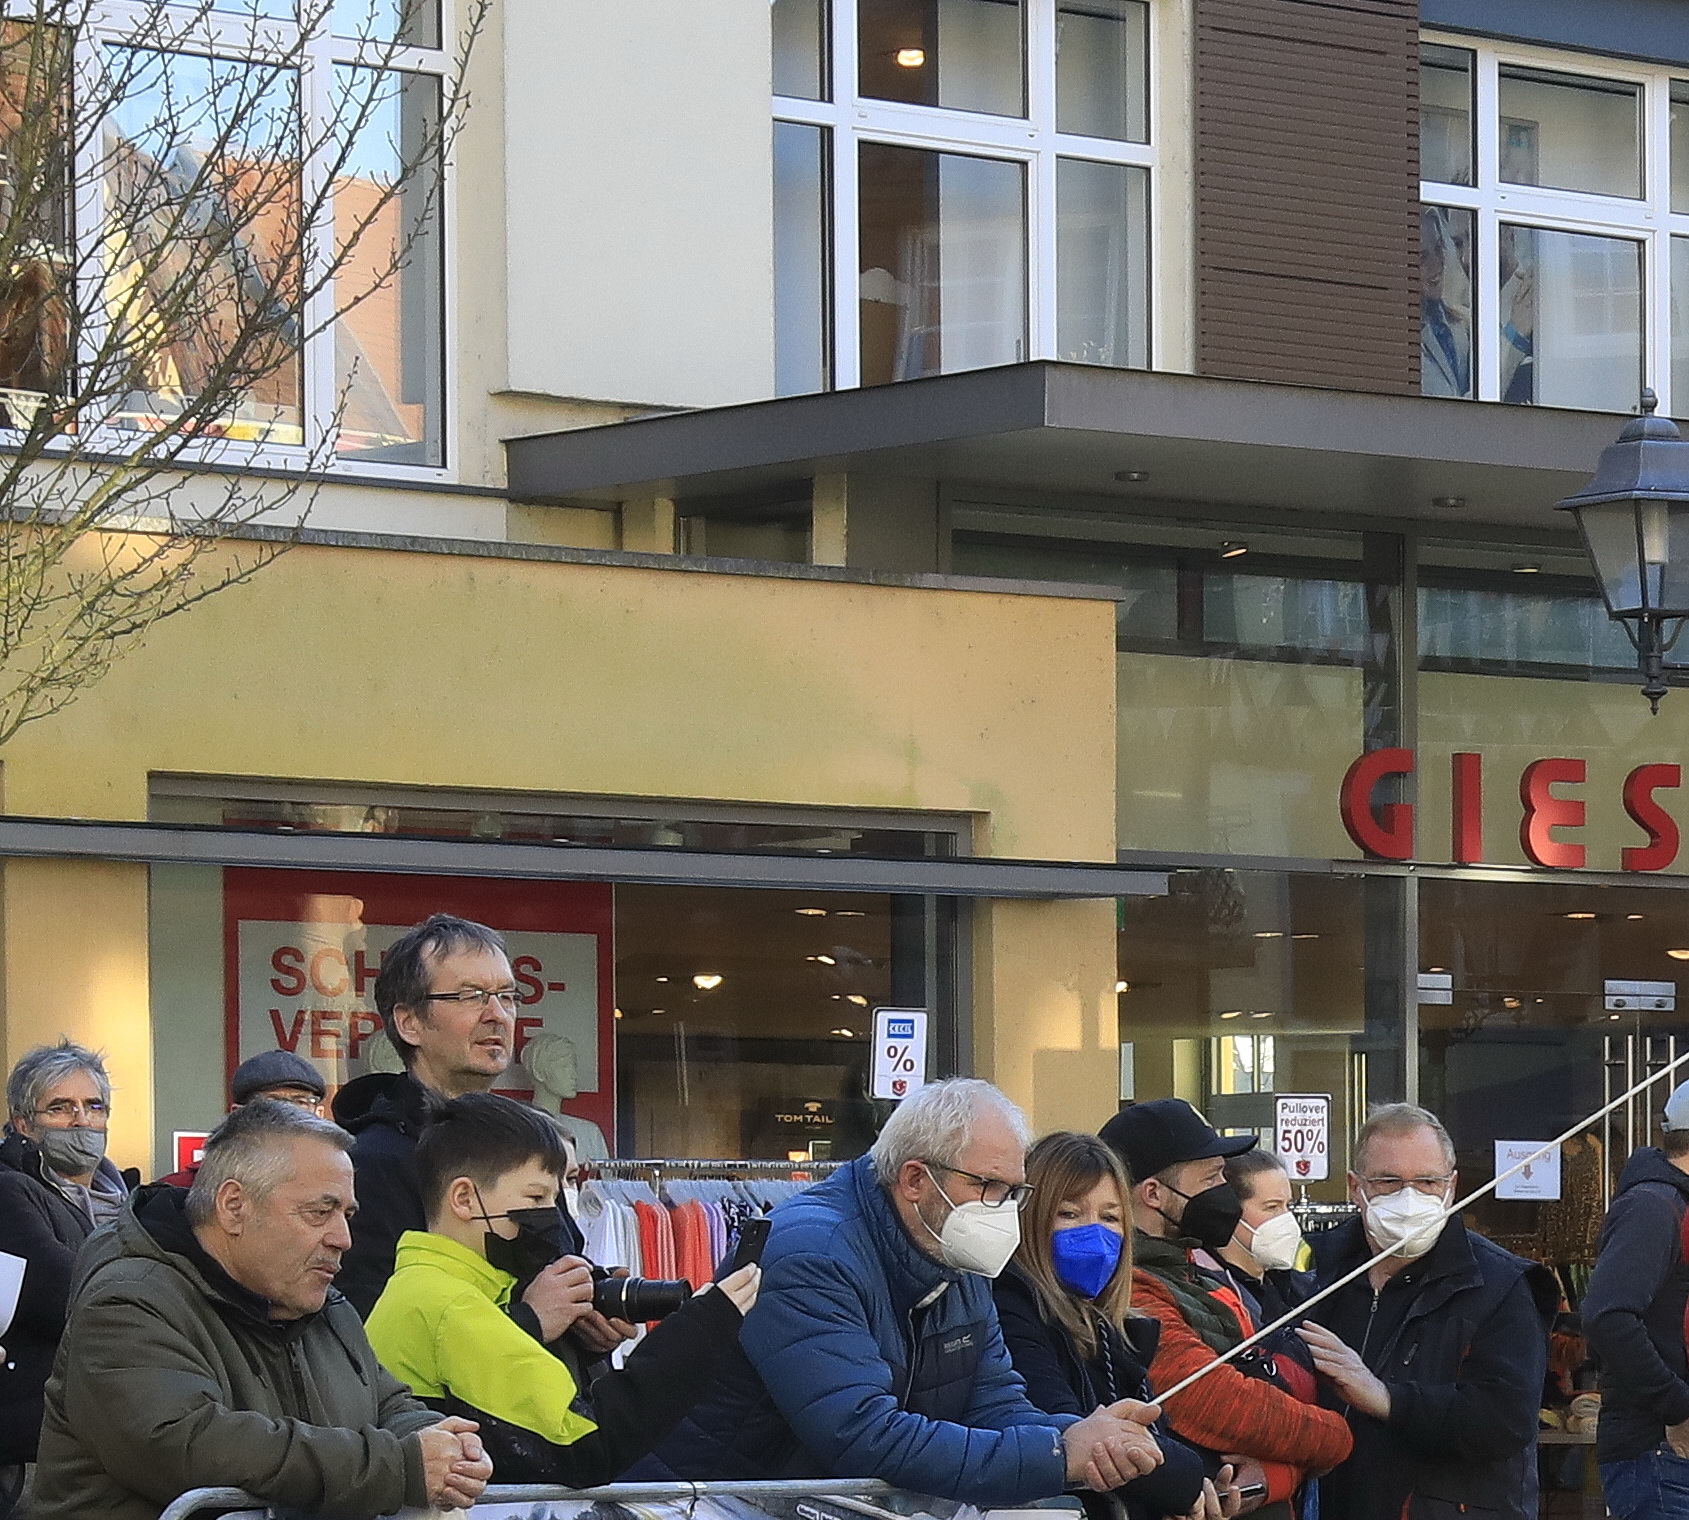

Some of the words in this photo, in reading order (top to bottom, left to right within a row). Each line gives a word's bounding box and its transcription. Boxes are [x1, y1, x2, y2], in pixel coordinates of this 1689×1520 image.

[1281, 1102, 1325, 1115] Pullover
[775, 1113, 804, 1124] TOM
[1280, 1115, 1325, 1128] reduziert
[1280, 1128, 1326, 1155] 50%
